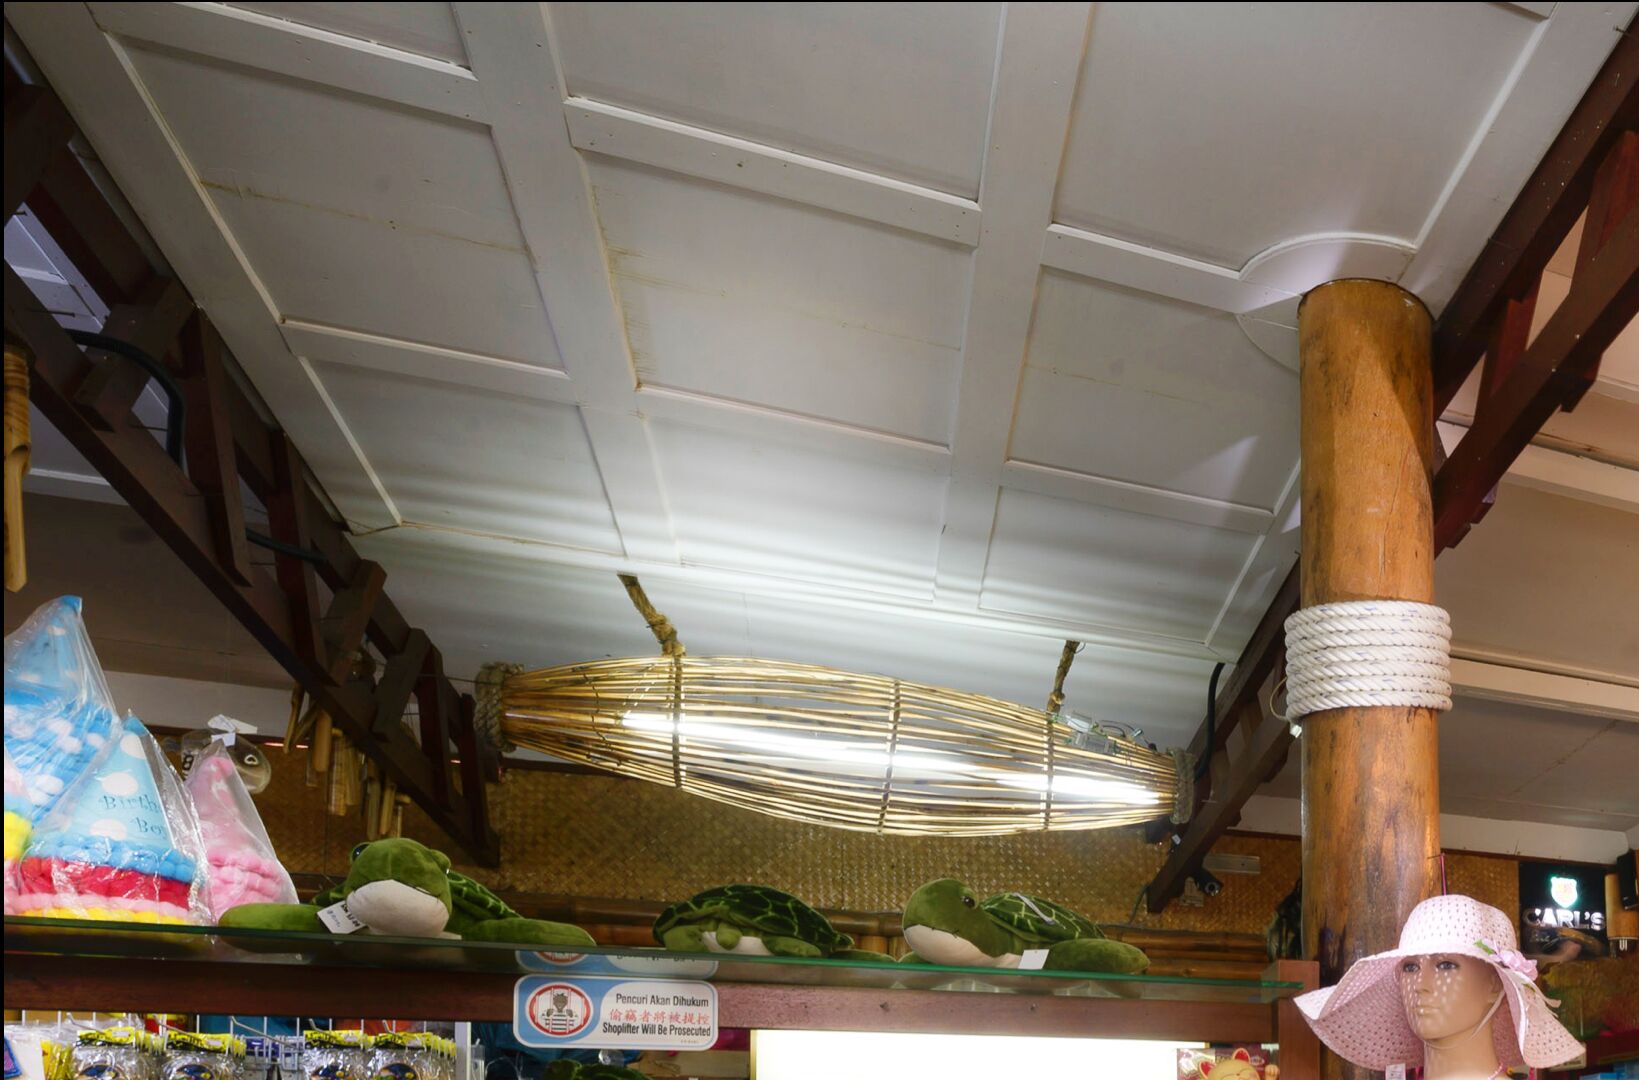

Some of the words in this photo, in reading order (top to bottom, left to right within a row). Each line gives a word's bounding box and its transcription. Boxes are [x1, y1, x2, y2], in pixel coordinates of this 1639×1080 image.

[616, 993, 648, 1005] Pencuri
[650, 995, 670, 1005] Akan
[673, 996, 709, 1007] Dihukum
[603, 1022, 639, 1036] Shoplifter
[641, 1024, 656, 1035] Will
[657, 1025, 667, 1035] Be
[669, 1025, 711, 1036] Prosecuted
